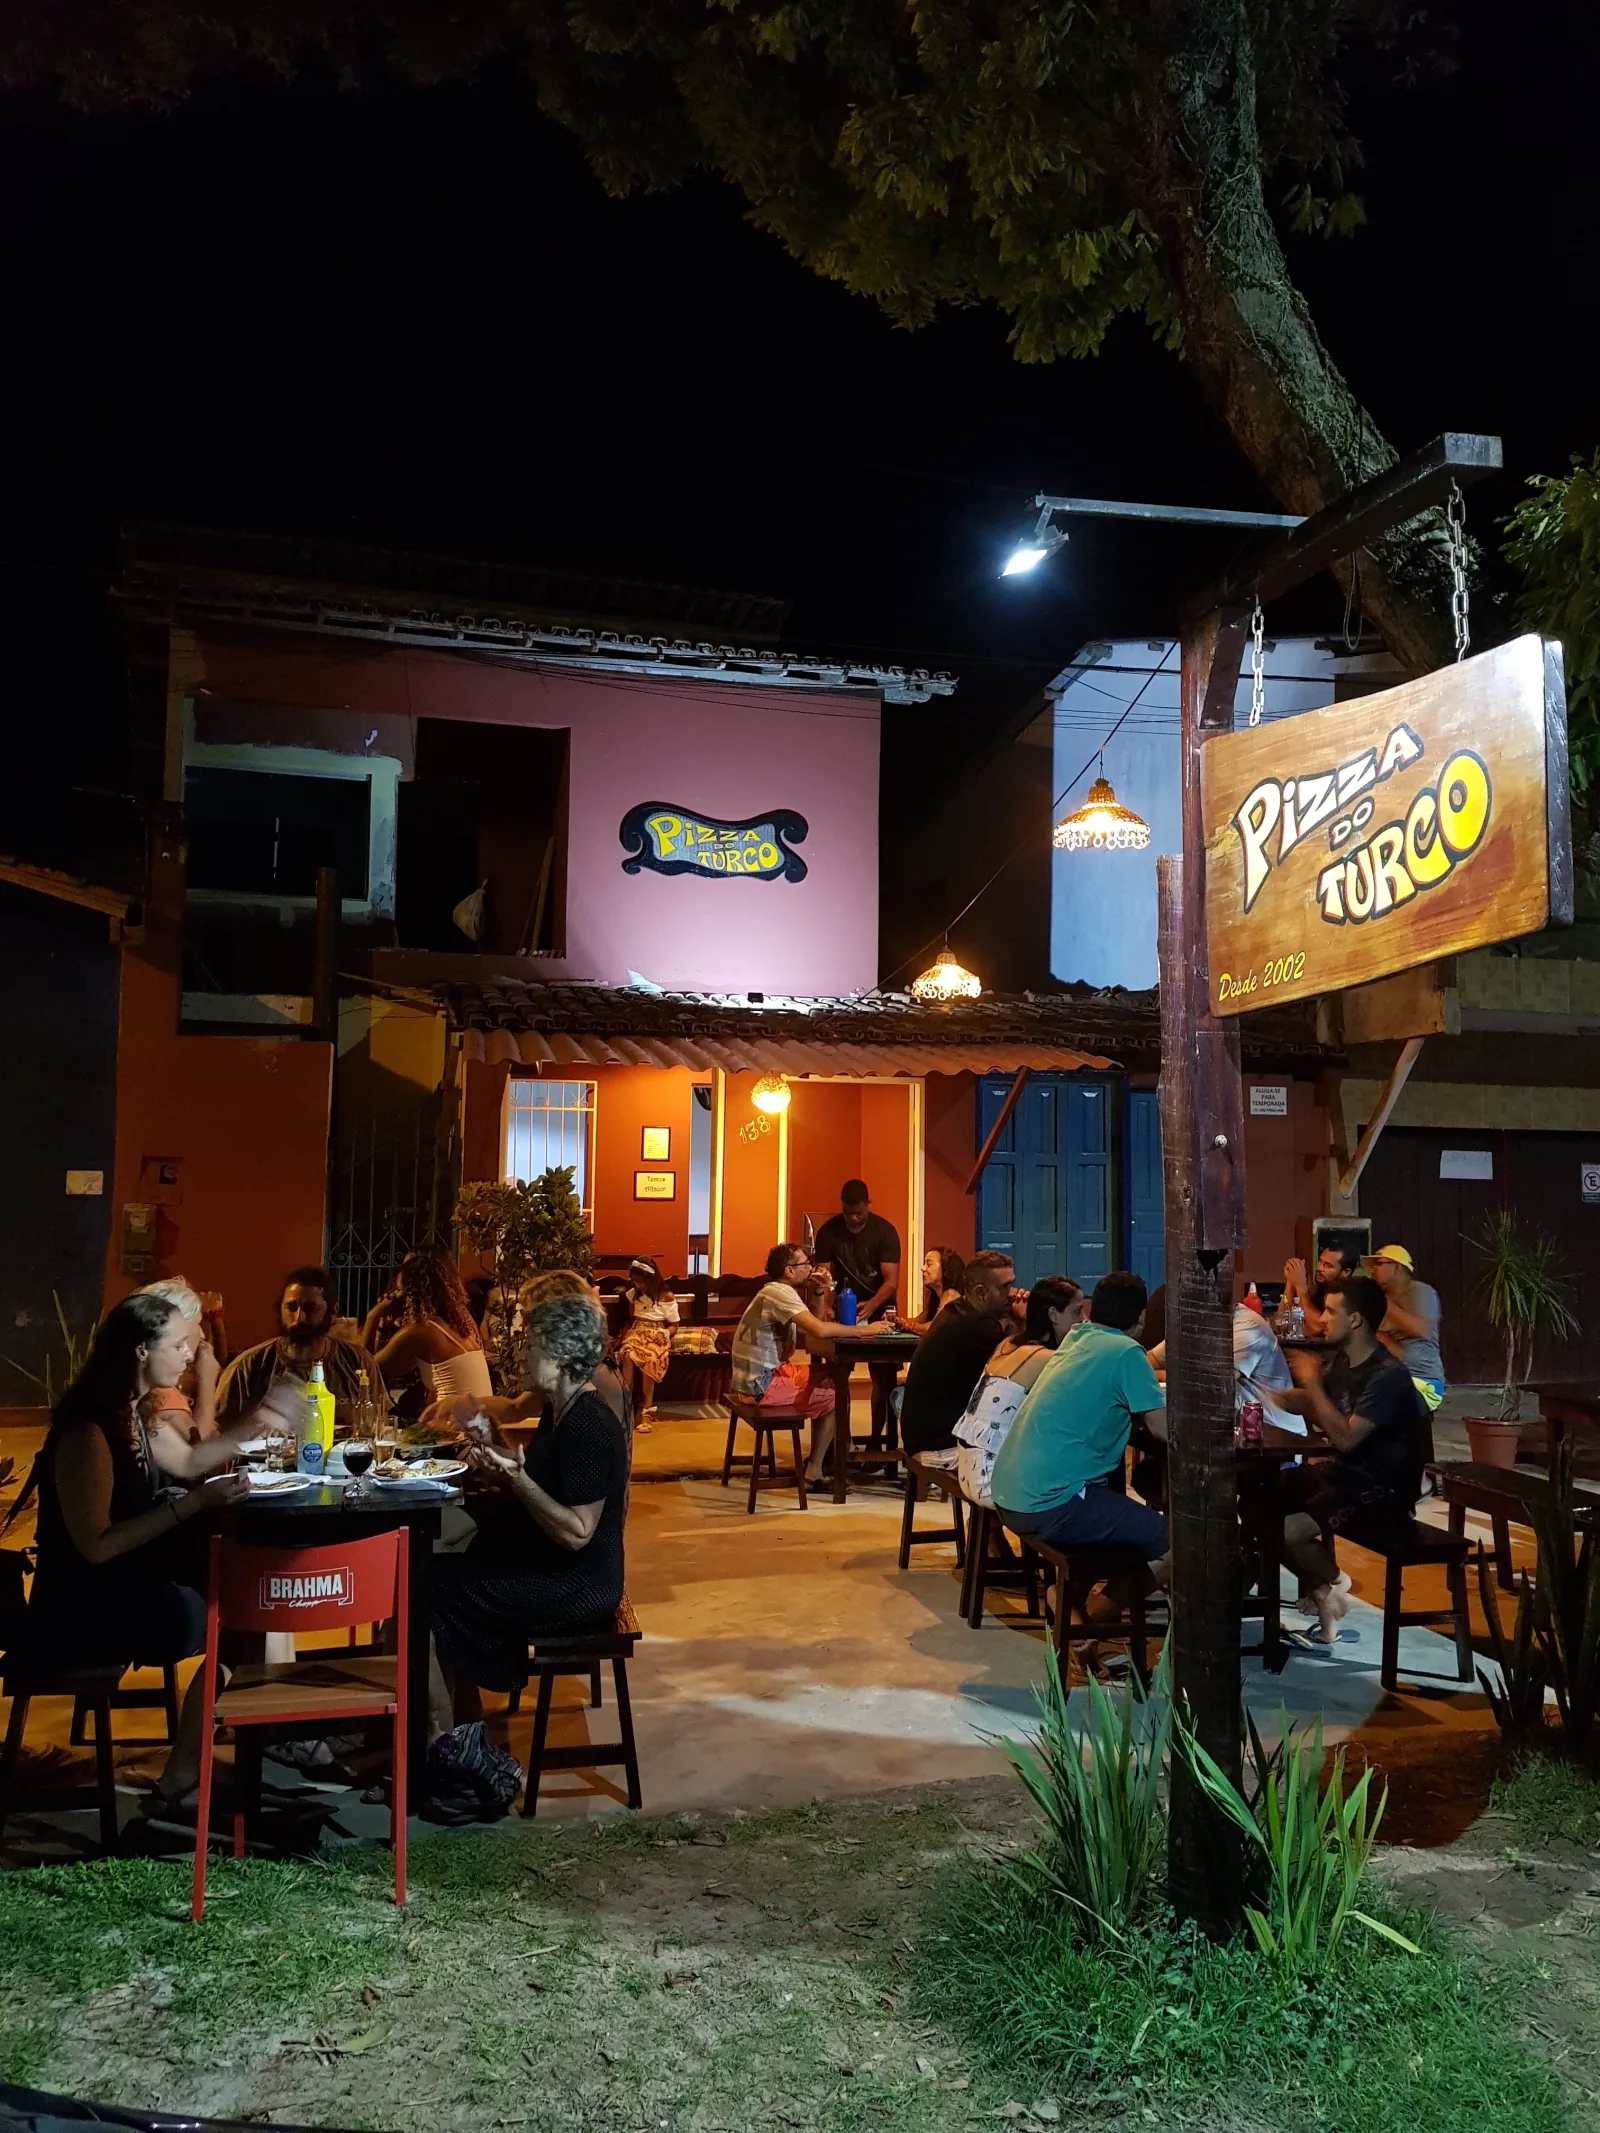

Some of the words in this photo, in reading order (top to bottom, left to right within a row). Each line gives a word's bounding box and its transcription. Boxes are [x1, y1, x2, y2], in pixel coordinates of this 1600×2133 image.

[1318, 750, 1490, 924] TURCO
[1331, 798, 1373, 849] DO
[697, 842, 778, 872] TURCO
[1219, 968, 1258, 1001] Desde
[1263, 950, 1306, 988] 2002
[739, 1115, 771, 1144] 138
[270, 1574, 343, 1599] BRAHMA
